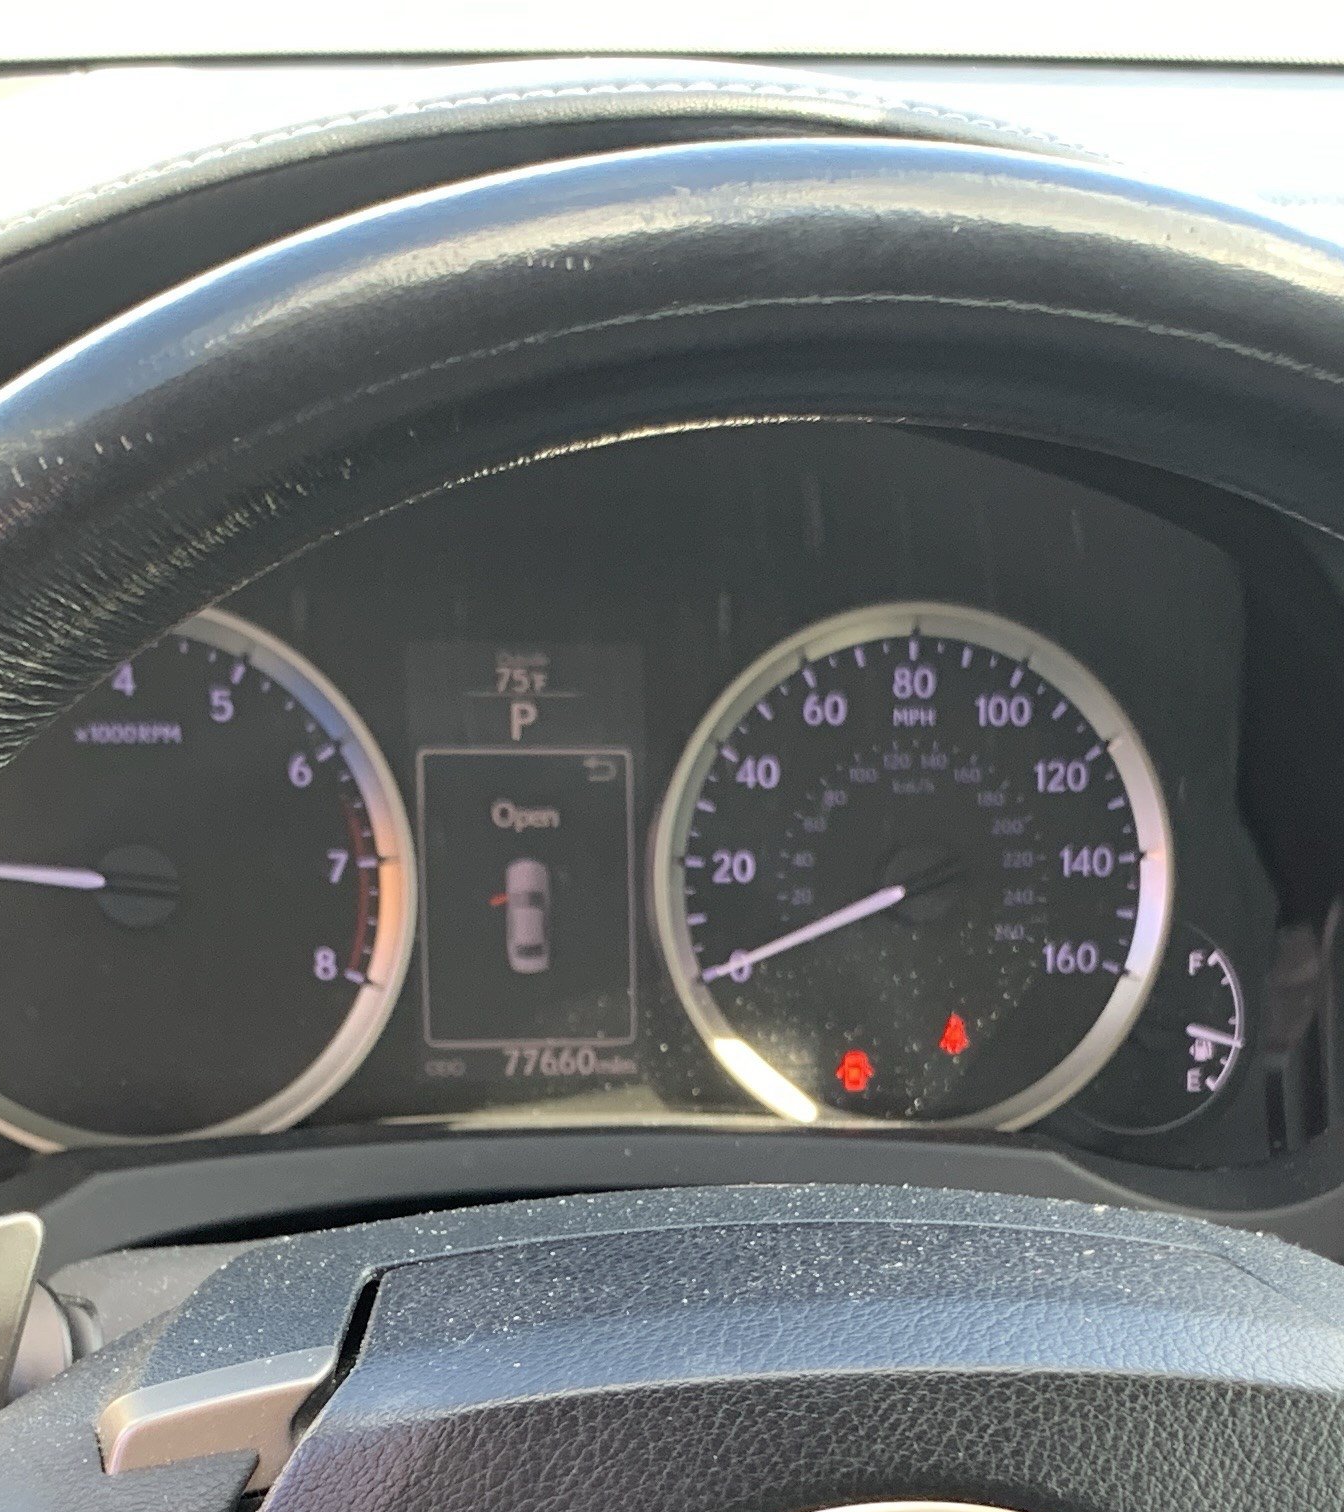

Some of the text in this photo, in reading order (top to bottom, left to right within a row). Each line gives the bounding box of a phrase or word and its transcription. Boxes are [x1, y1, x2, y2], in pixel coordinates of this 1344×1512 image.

[111, 660, 135, 695] 4
[892, 665, 937, 699] 80
[209, 687, 234, 722] 5
[510, 701, 537, 741] P
[803, 691, 848, 726] 60
[892, 707, 937, 727] MPH
[975, 695, 1032, 727] 100
[288, 753, 312, 787] 6
[736, 756, 781, 789] 40
[1034, 760, 1088, 793] 120
[326, 848, 348, 883] 7
[712, 850, 756, 884] 20
[1060, 846, 1114, 878] 140
[314, 946, 336, 981] 8
[1042, 943, 1098, 974] 160
[1189, 951, 1203, 975] F
[504, 1047, 597, 1076] 77660
[1187, 1068, 1201, 1092] E
